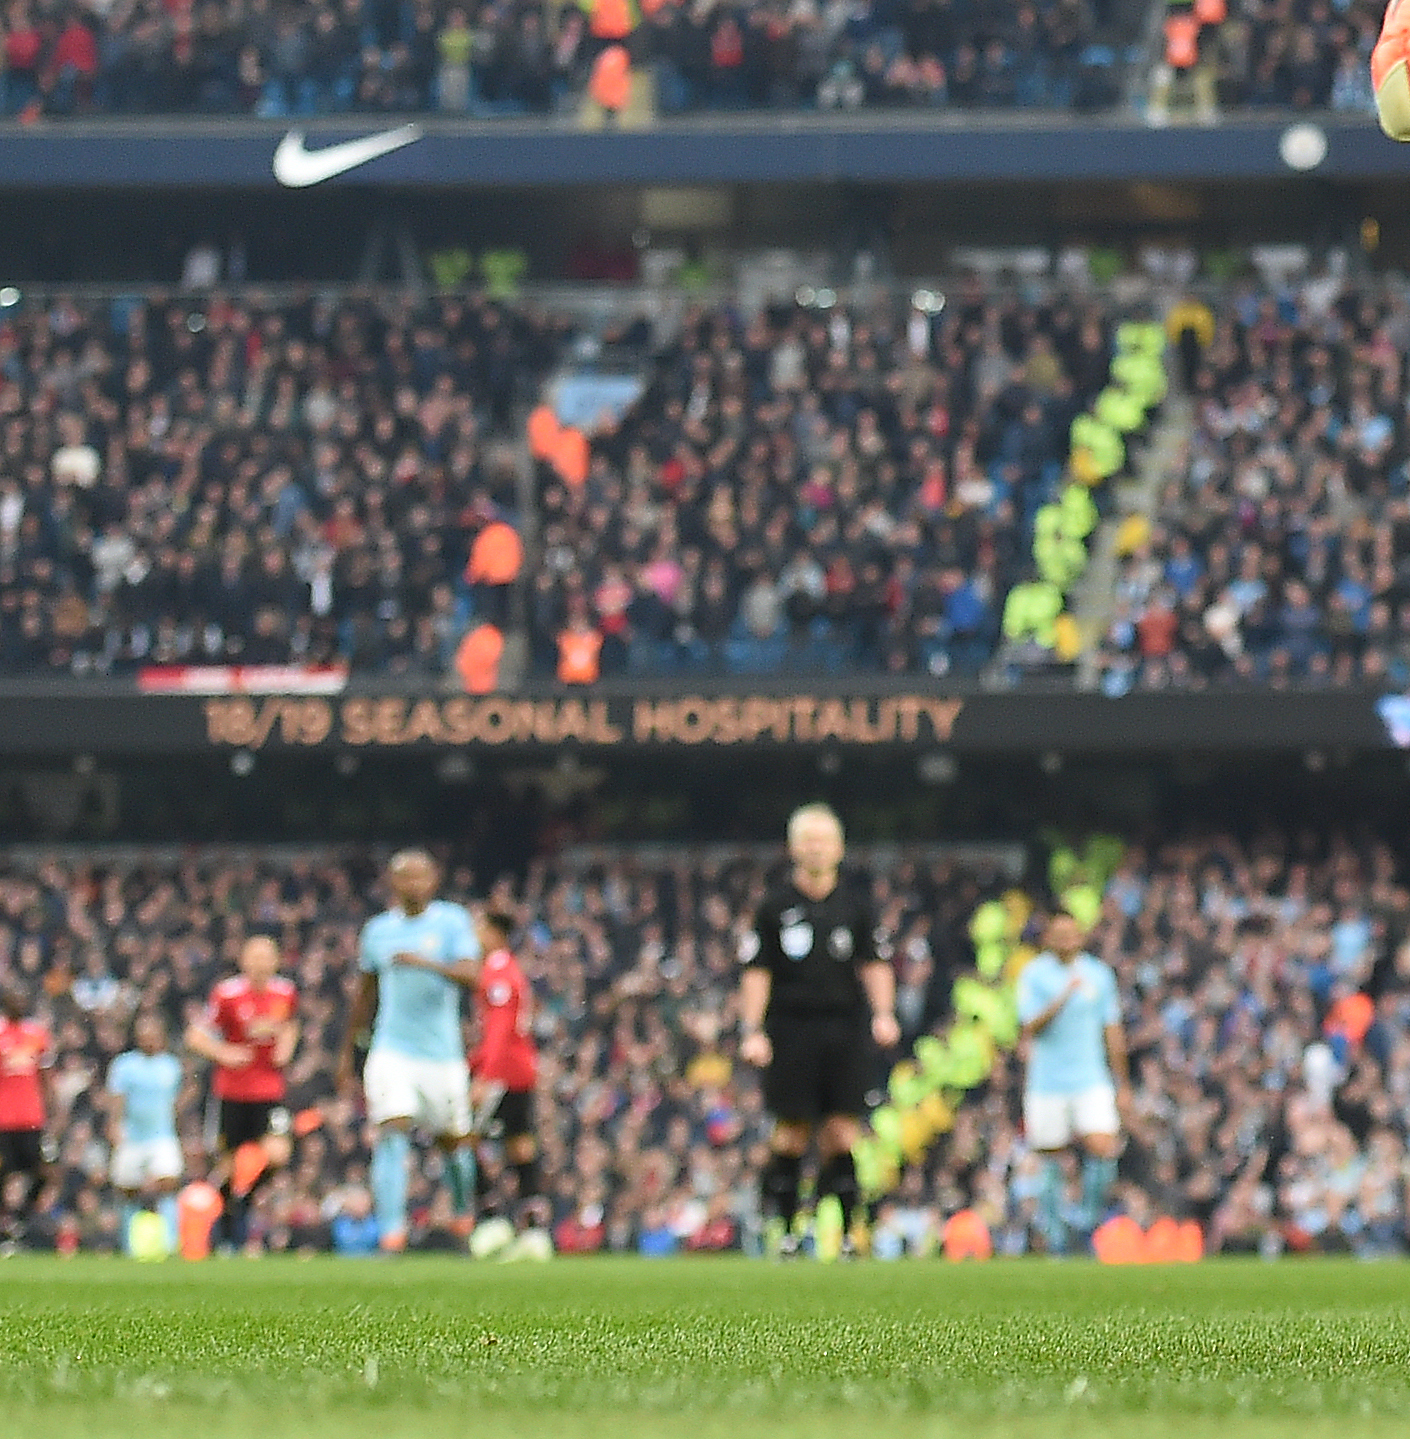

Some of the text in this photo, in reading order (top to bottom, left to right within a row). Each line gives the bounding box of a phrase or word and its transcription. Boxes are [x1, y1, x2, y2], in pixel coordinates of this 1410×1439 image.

[204, 694, 965, 750] 18/19 SEASONAL HOSPITALITY
